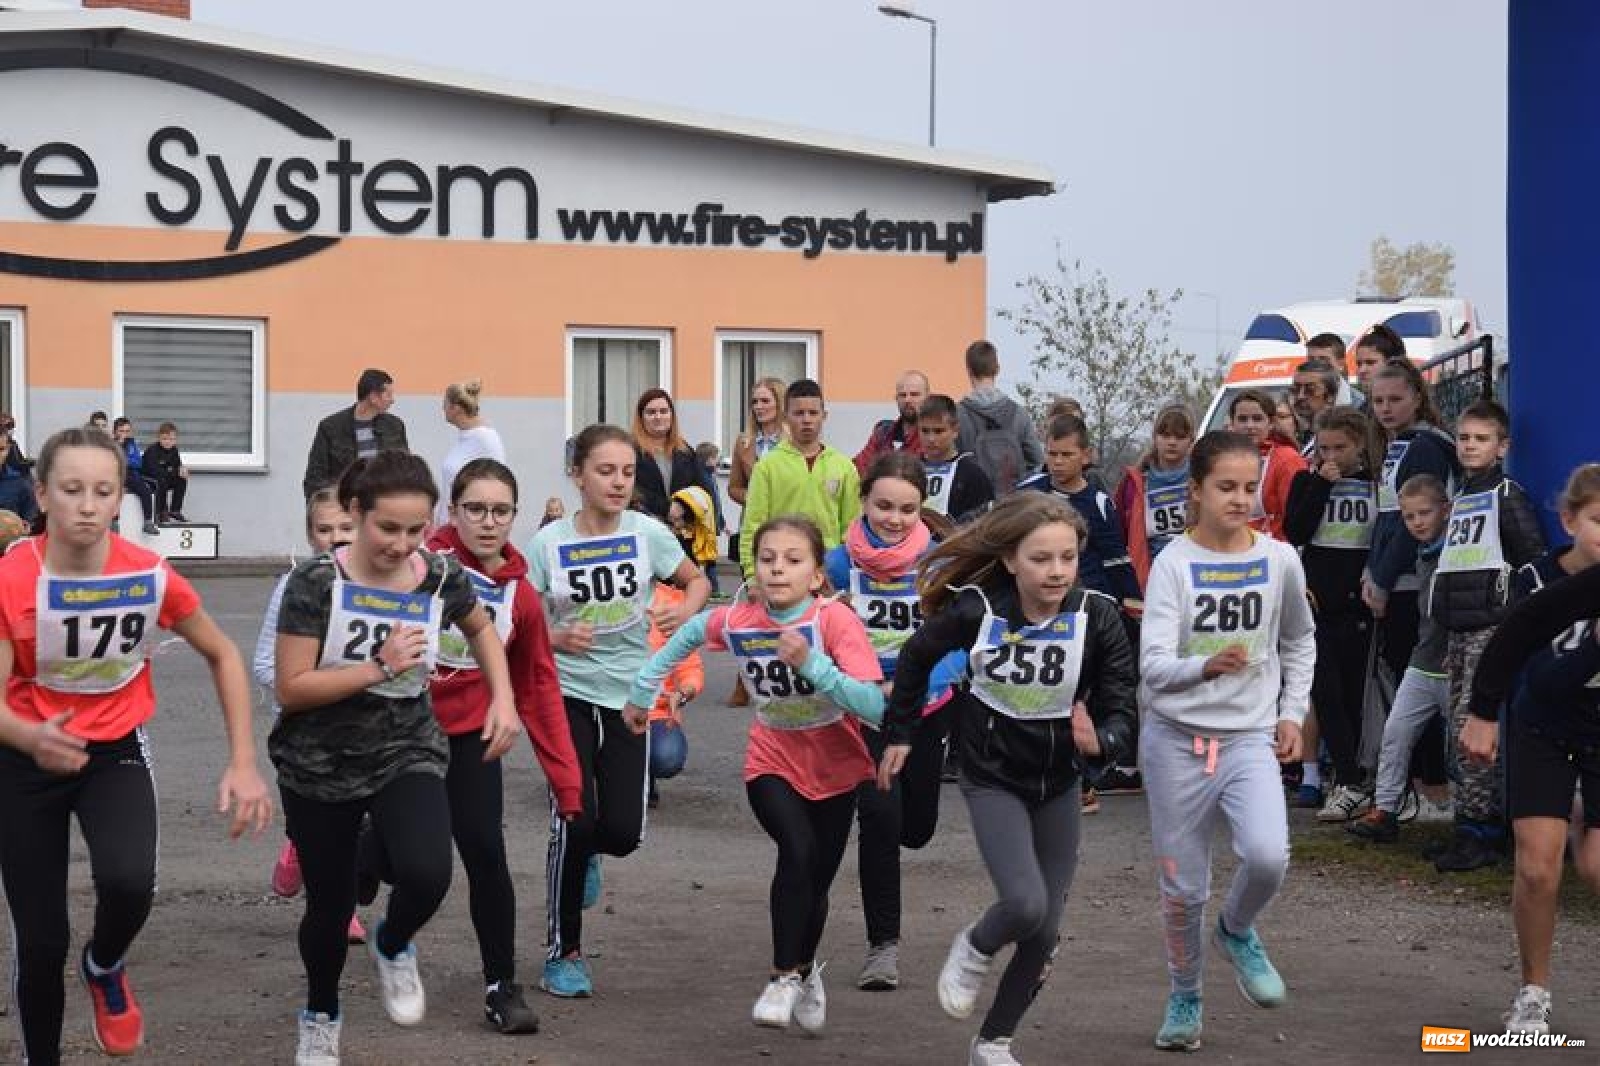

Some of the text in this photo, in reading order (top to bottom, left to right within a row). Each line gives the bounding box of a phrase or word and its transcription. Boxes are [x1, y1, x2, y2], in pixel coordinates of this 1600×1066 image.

[145, 126, 538, 252] System
[557, 203, 984, 263] www.fire-system.pl
[180, 529, 193, 550] 3
[1154, 505, 1185, 531] 95
[1447, 514, 1487, 547] 297
[567, 561, 638, 604] 503
[1193, 591, 1263, 633] 260
[61, 612, 147, 658] 179
[985, 643, 1067, 687] 258
